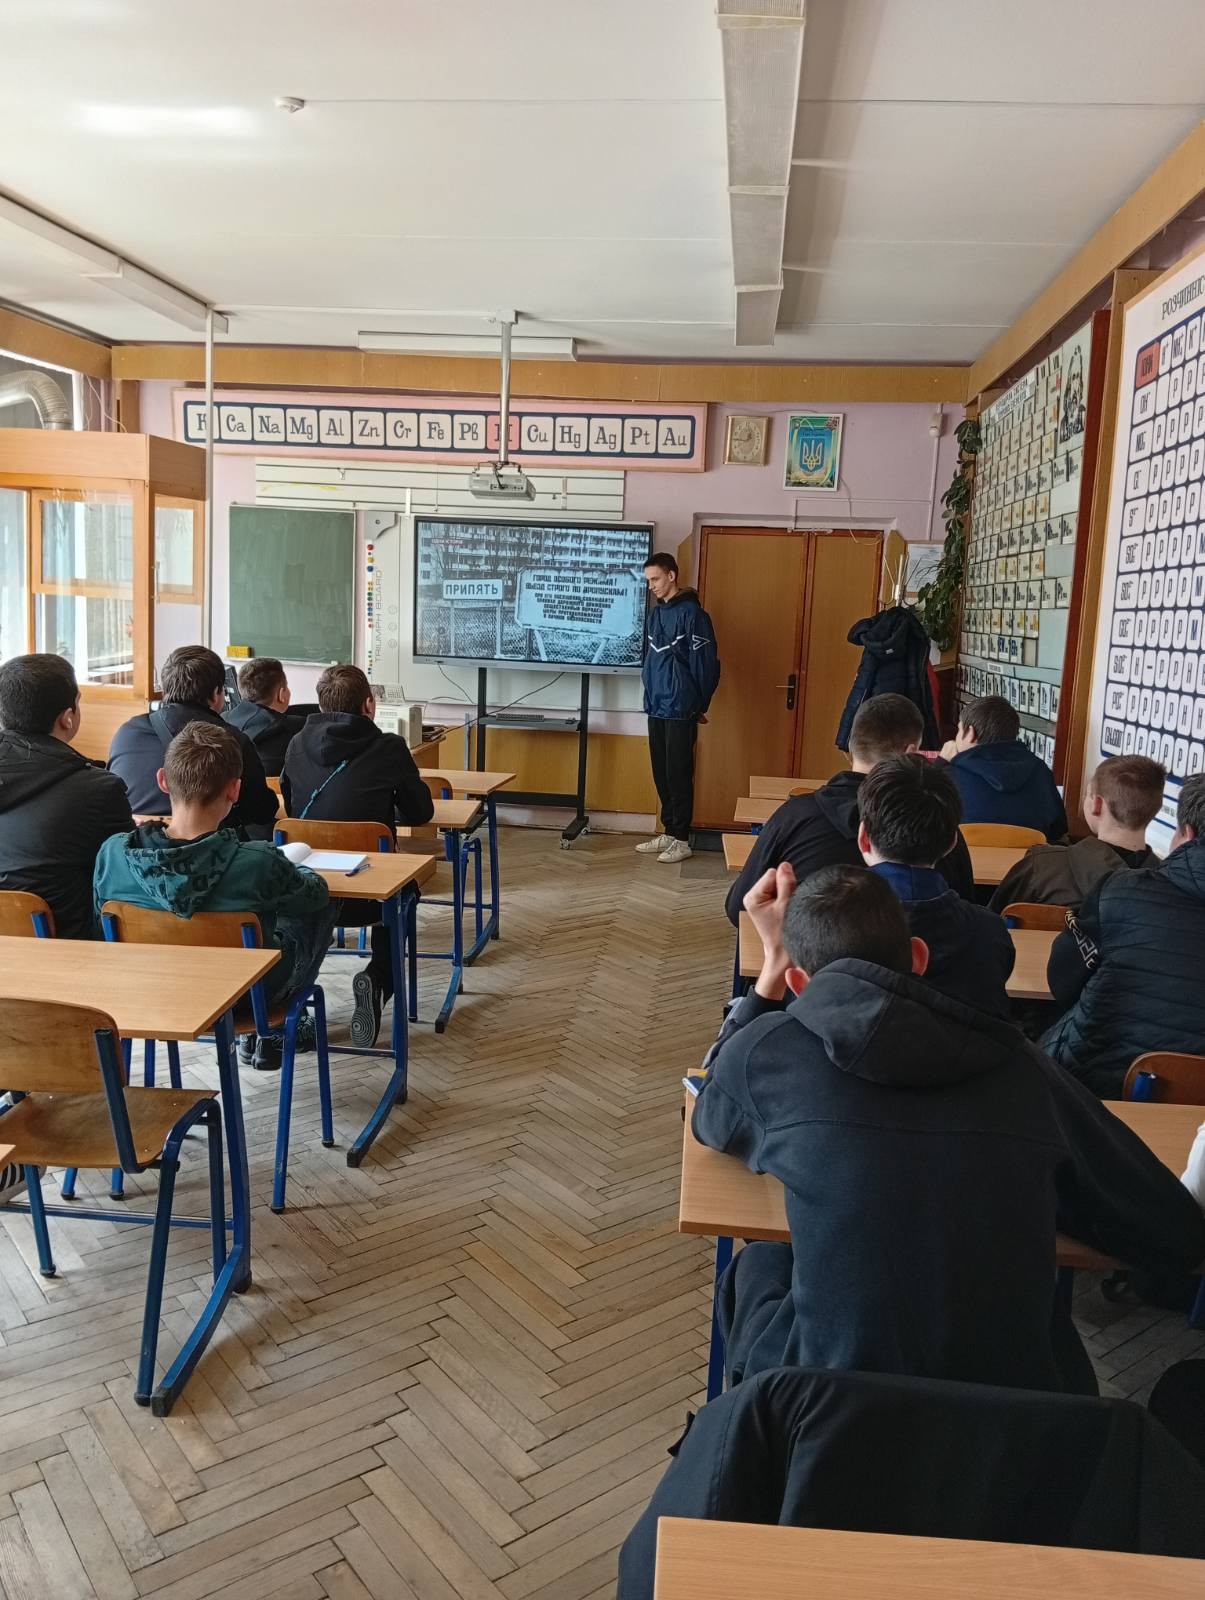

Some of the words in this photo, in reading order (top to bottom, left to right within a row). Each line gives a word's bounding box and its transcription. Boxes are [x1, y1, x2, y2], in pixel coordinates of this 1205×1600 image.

[226, 414, 246, 433] Ca
[258, 415, 281, 434] Na
[290, 416, 313, 440] Mg
[326, 417, 344, 437] Al
[358, 419, 380, 438] Zn
[393, 419, 412, 439] Cr
[527, 424, 548, 443] Cu
[559, 425, 581, 448] Hg
[594, 425, 617, 450] Ag
[630, 426, 650, 446] Pt
[663, 427, 687, 446] Au
[554, 575, 581, 584] ОСОБОГО
[446, 584, 498, 595] ПРИПЯТЬ
[547, 584, 570, 592] СТРОГО
[572, 585, 581, 593] ПО
